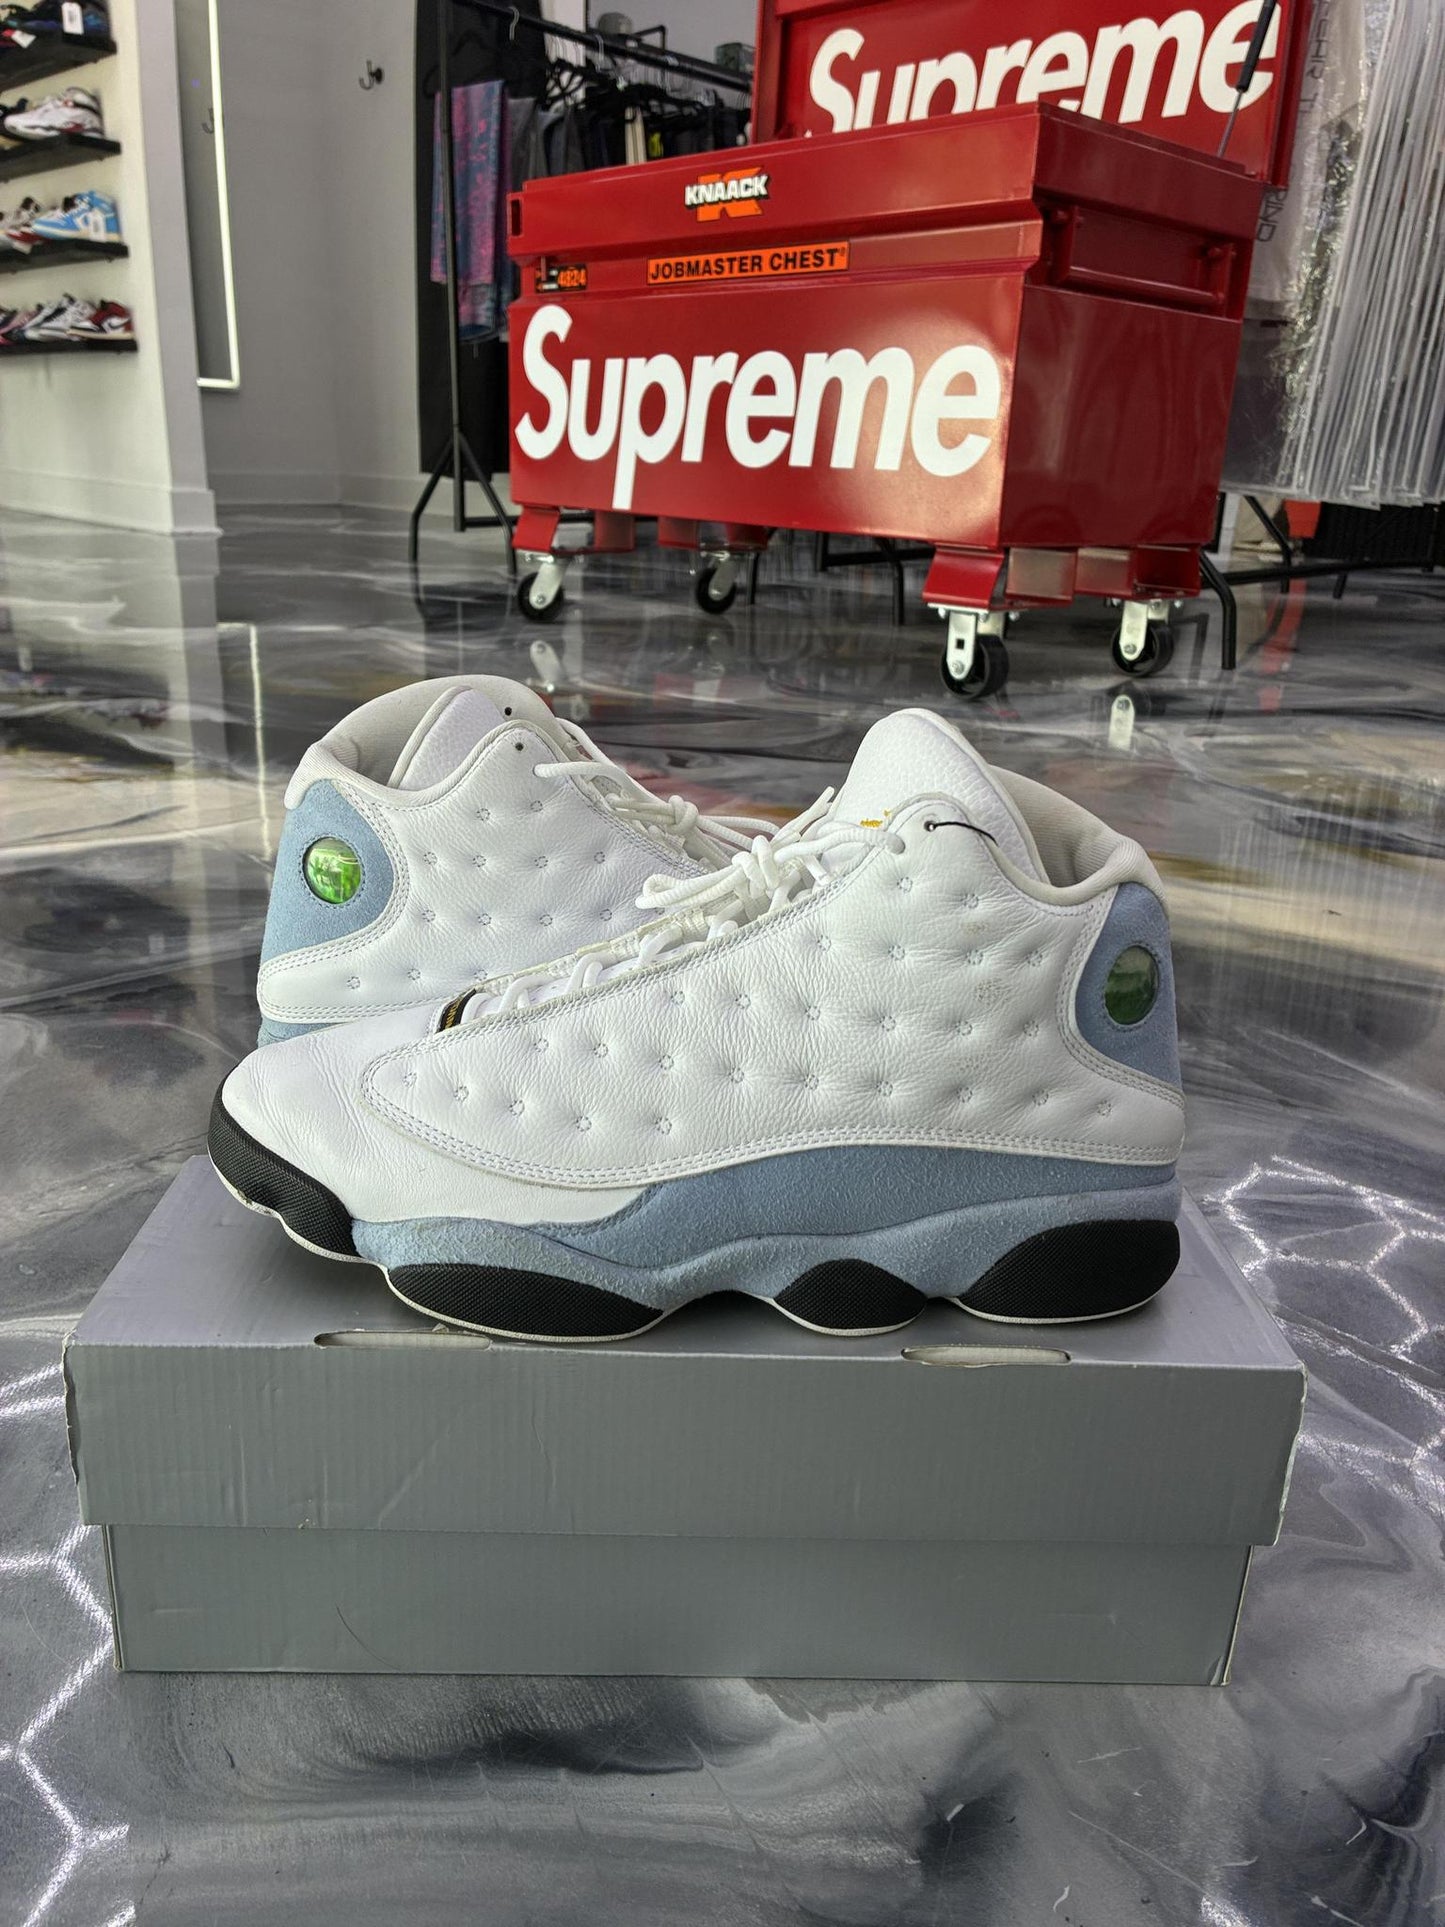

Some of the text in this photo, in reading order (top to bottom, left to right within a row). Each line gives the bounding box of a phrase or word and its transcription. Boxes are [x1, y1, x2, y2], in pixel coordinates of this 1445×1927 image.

[685, 174, 769, 206] KNAACK
[651, 256, 763, 280] JOBMASTER
[515, 304, 1001, 511] Supreme
